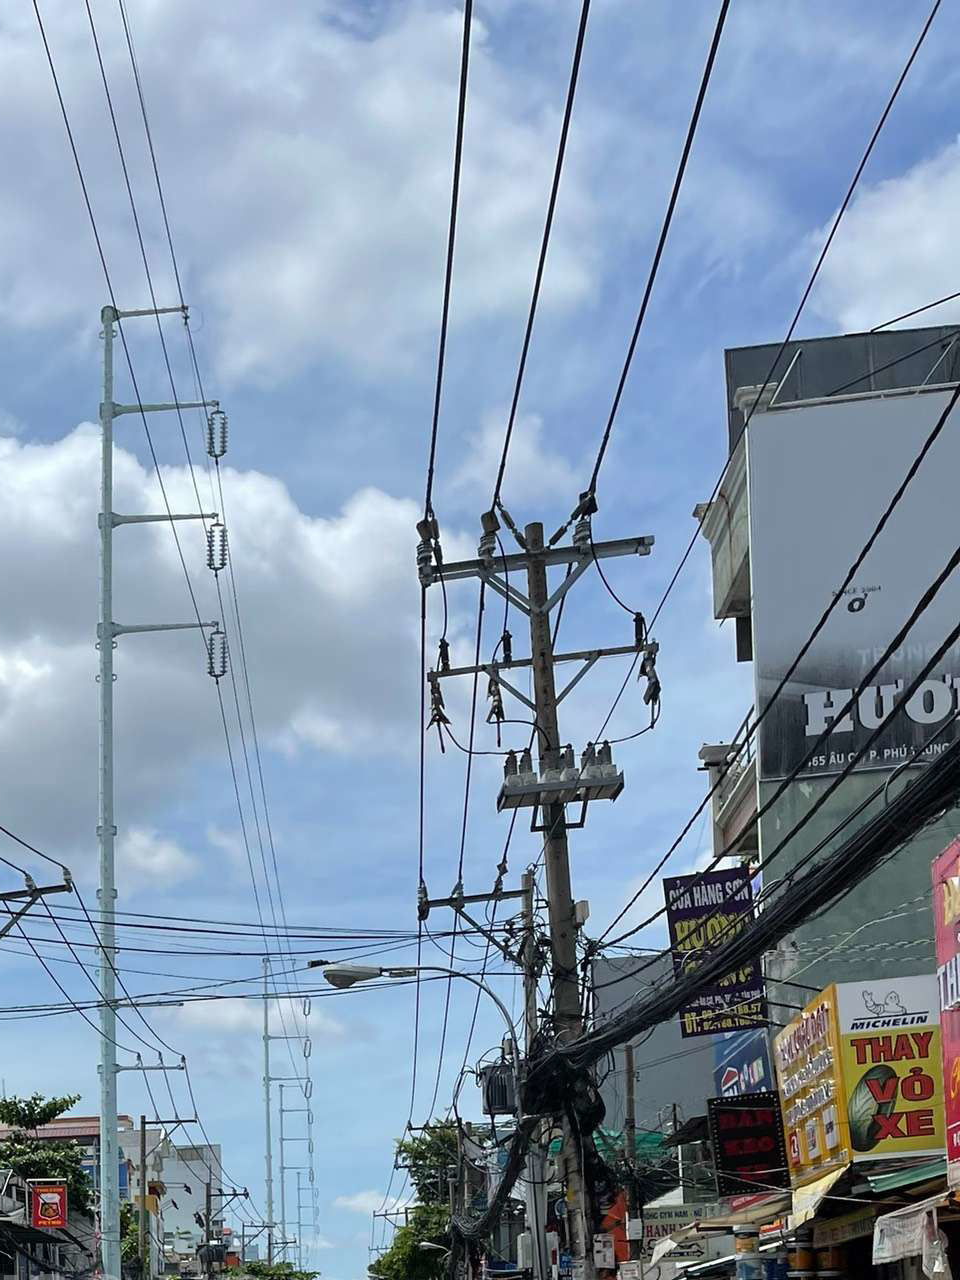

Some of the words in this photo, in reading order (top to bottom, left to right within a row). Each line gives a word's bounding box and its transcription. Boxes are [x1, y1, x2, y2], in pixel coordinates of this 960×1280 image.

[802, 674, 960, 737] HƯƠ
[807, 754, 826, 767] 65
[829, 751, 845, 764] ÂU
[884, 744, 908, 758] PHÚ
[692, 881, 724, 908] HÀNG
[850, 1015, 929, 1031] MICHELIN
[850, 1031, 934, 1065] THAY
[865, 1066, 935, 1105] VỎ
[872, 1109, 936, 1142] XE
[674, 1210, 688, 1219] NAM
